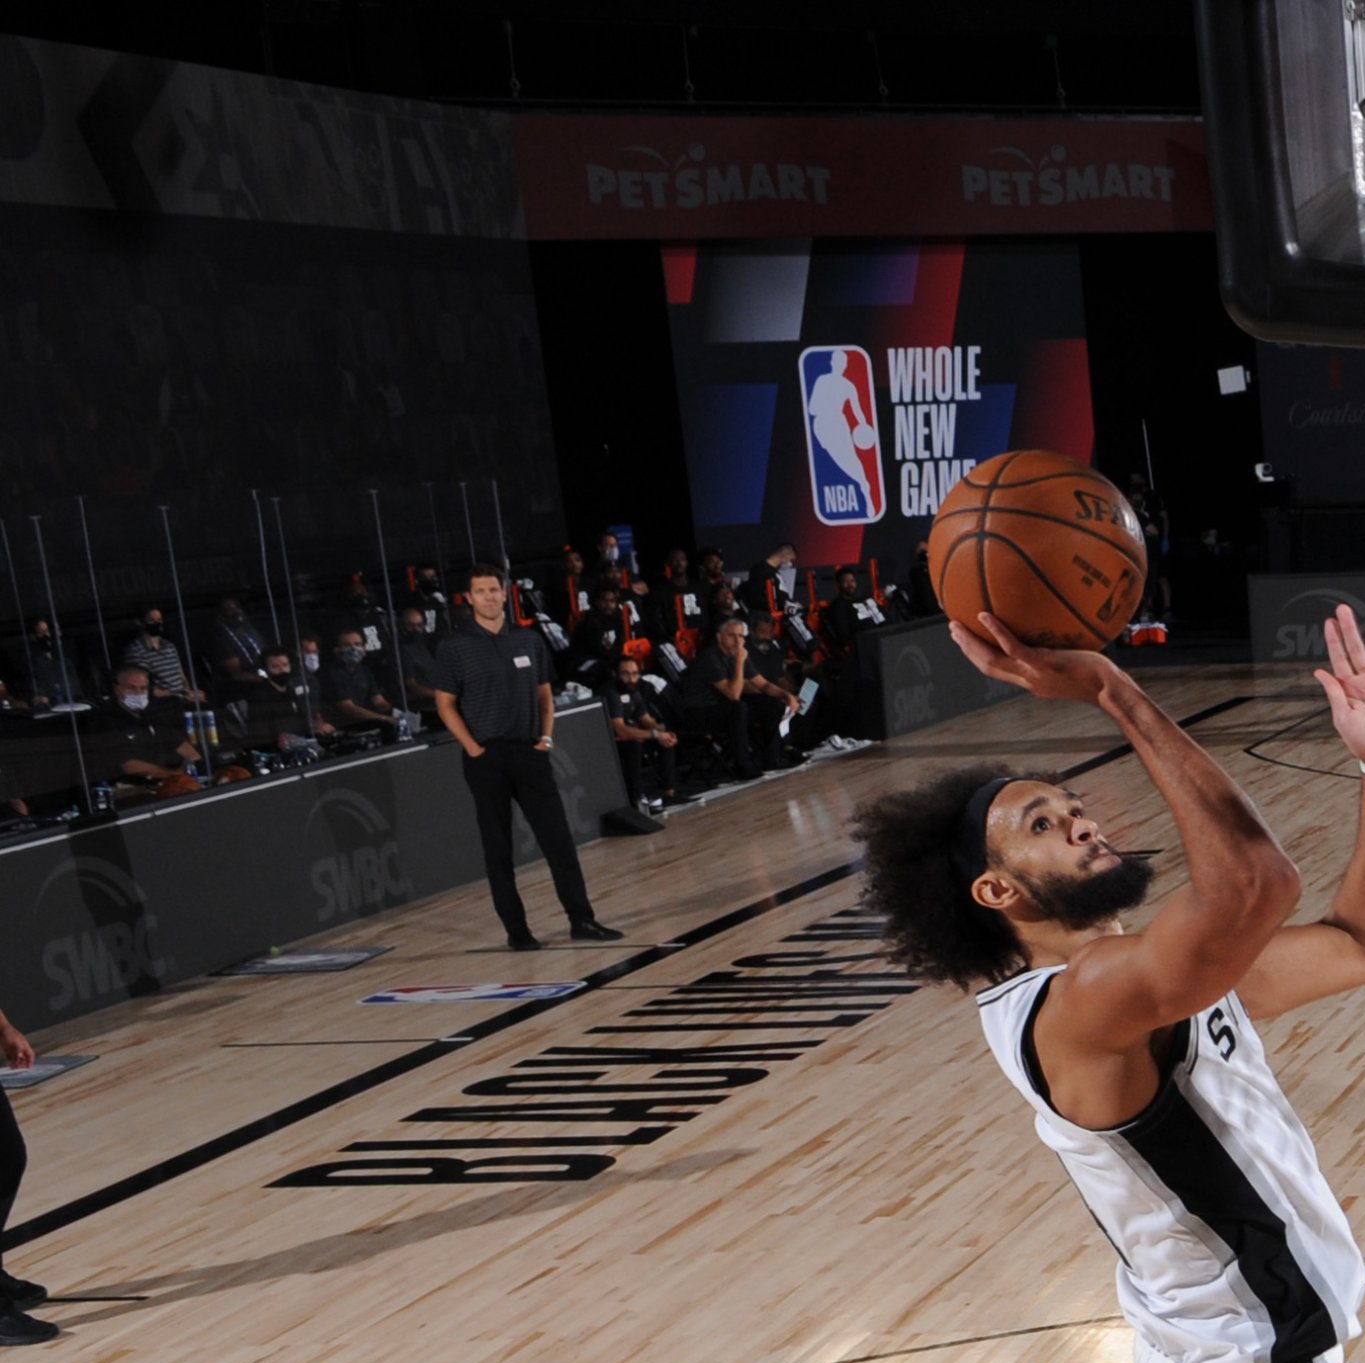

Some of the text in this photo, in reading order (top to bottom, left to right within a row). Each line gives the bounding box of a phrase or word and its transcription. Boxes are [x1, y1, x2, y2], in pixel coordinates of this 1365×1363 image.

[887, 345, 982, 403] WHOLE
[895, 403, 957, 460] NEW
[824, 484, 859, 513] NBA
[901, 459, 976, 518] GAM
[311, 840, 401, 923] SWBC
[42, 916, 167, 1011] SWBC
[262, 1038, 826, 1188] BLACK
